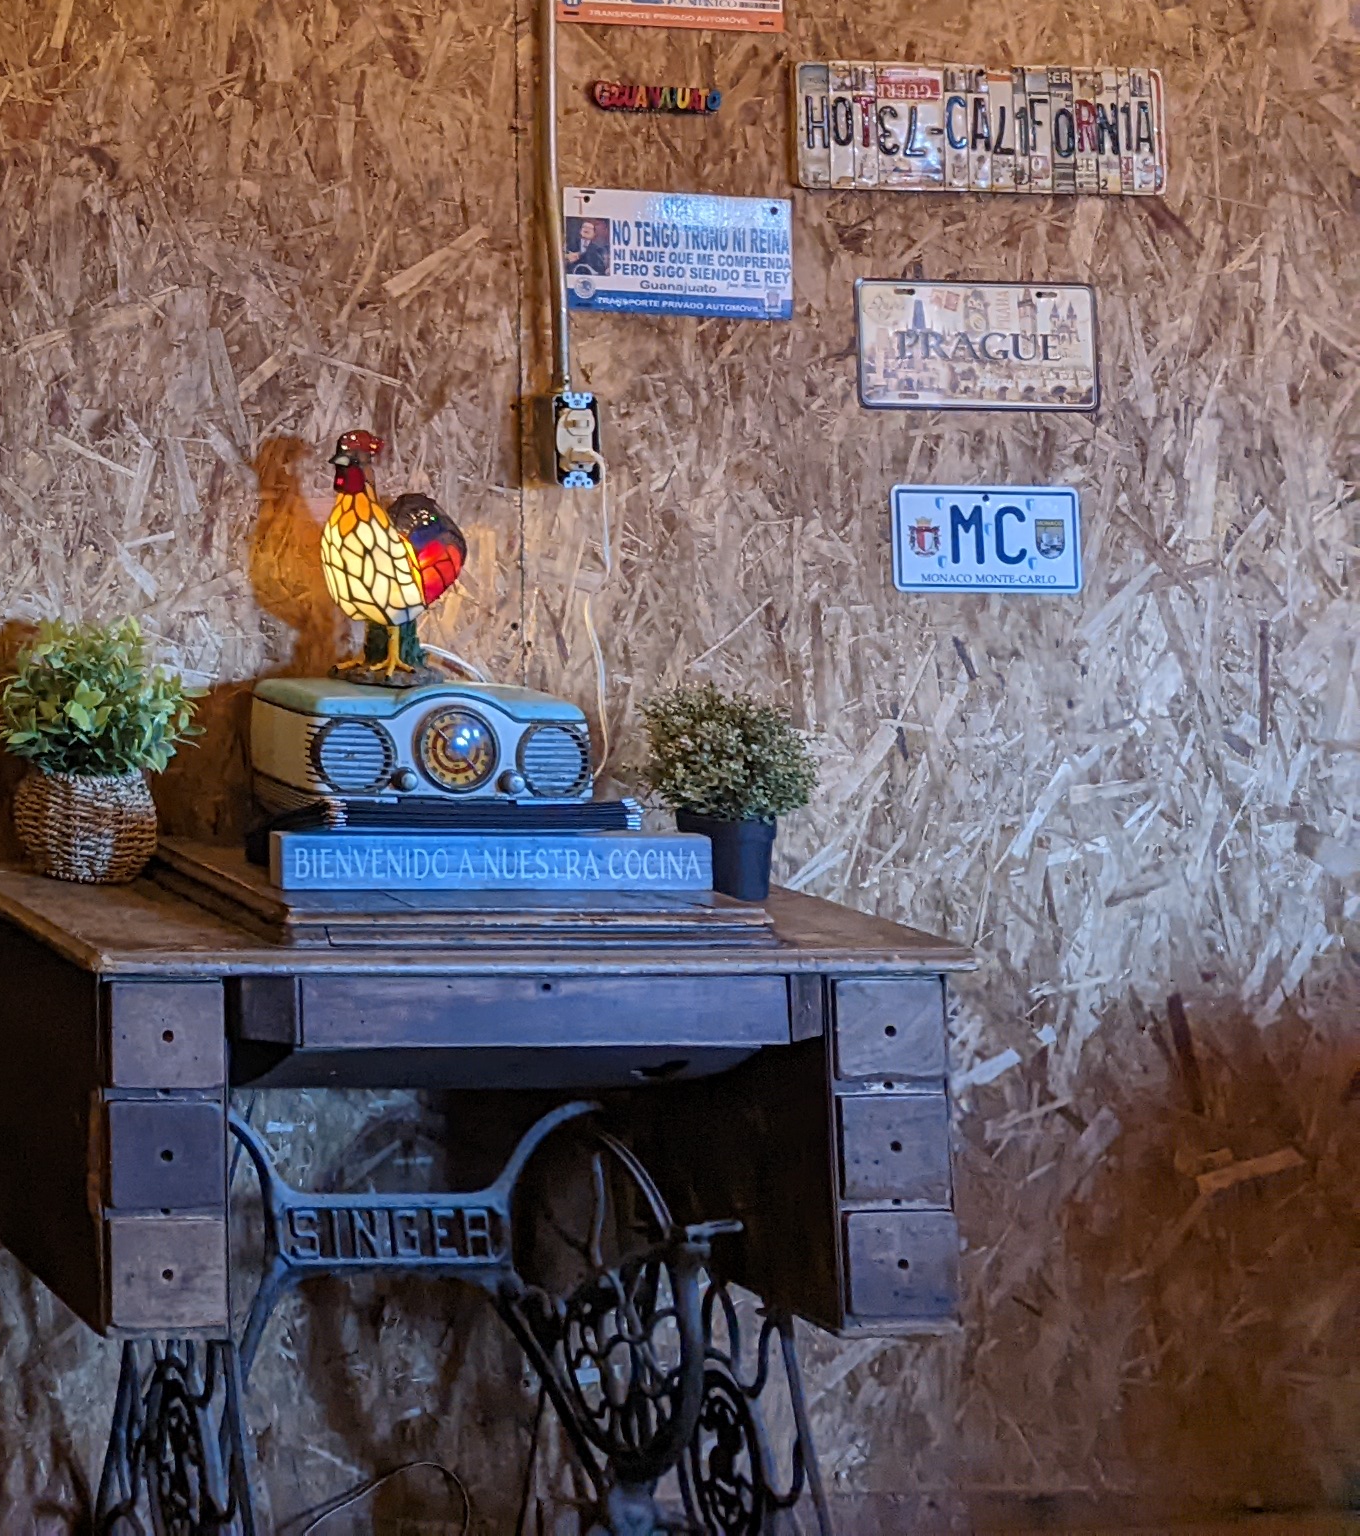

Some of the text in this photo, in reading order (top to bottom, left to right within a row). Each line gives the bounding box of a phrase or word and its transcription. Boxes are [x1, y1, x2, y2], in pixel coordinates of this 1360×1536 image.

[589, 9, 650, 20] TRANSPORTE
[612, 220, 790, 256] NO TENGO TRONO NI REINA
[613, 248, 792, 271] NI NADIE QUE ME COMPRENDA
[613, 262, 790, 286] PERO SIGO SIENDO EL REY
[639, 280, 718, 295] Guanajuato
[597, 297, 660, 310] TRANSPORTE
[661, 299, 704, 311] PRIVADO
[894, 329, 1062, 361] PRAGUE
[949, 503, 1028, 566] MC
[921, 573, 1057, 585] MONACO MONTE-CARLO
[293, 846, 703, 882] BIENVENIDO A NUESTRA COCINA
[292, 1209, 497, 1261] SINGER
